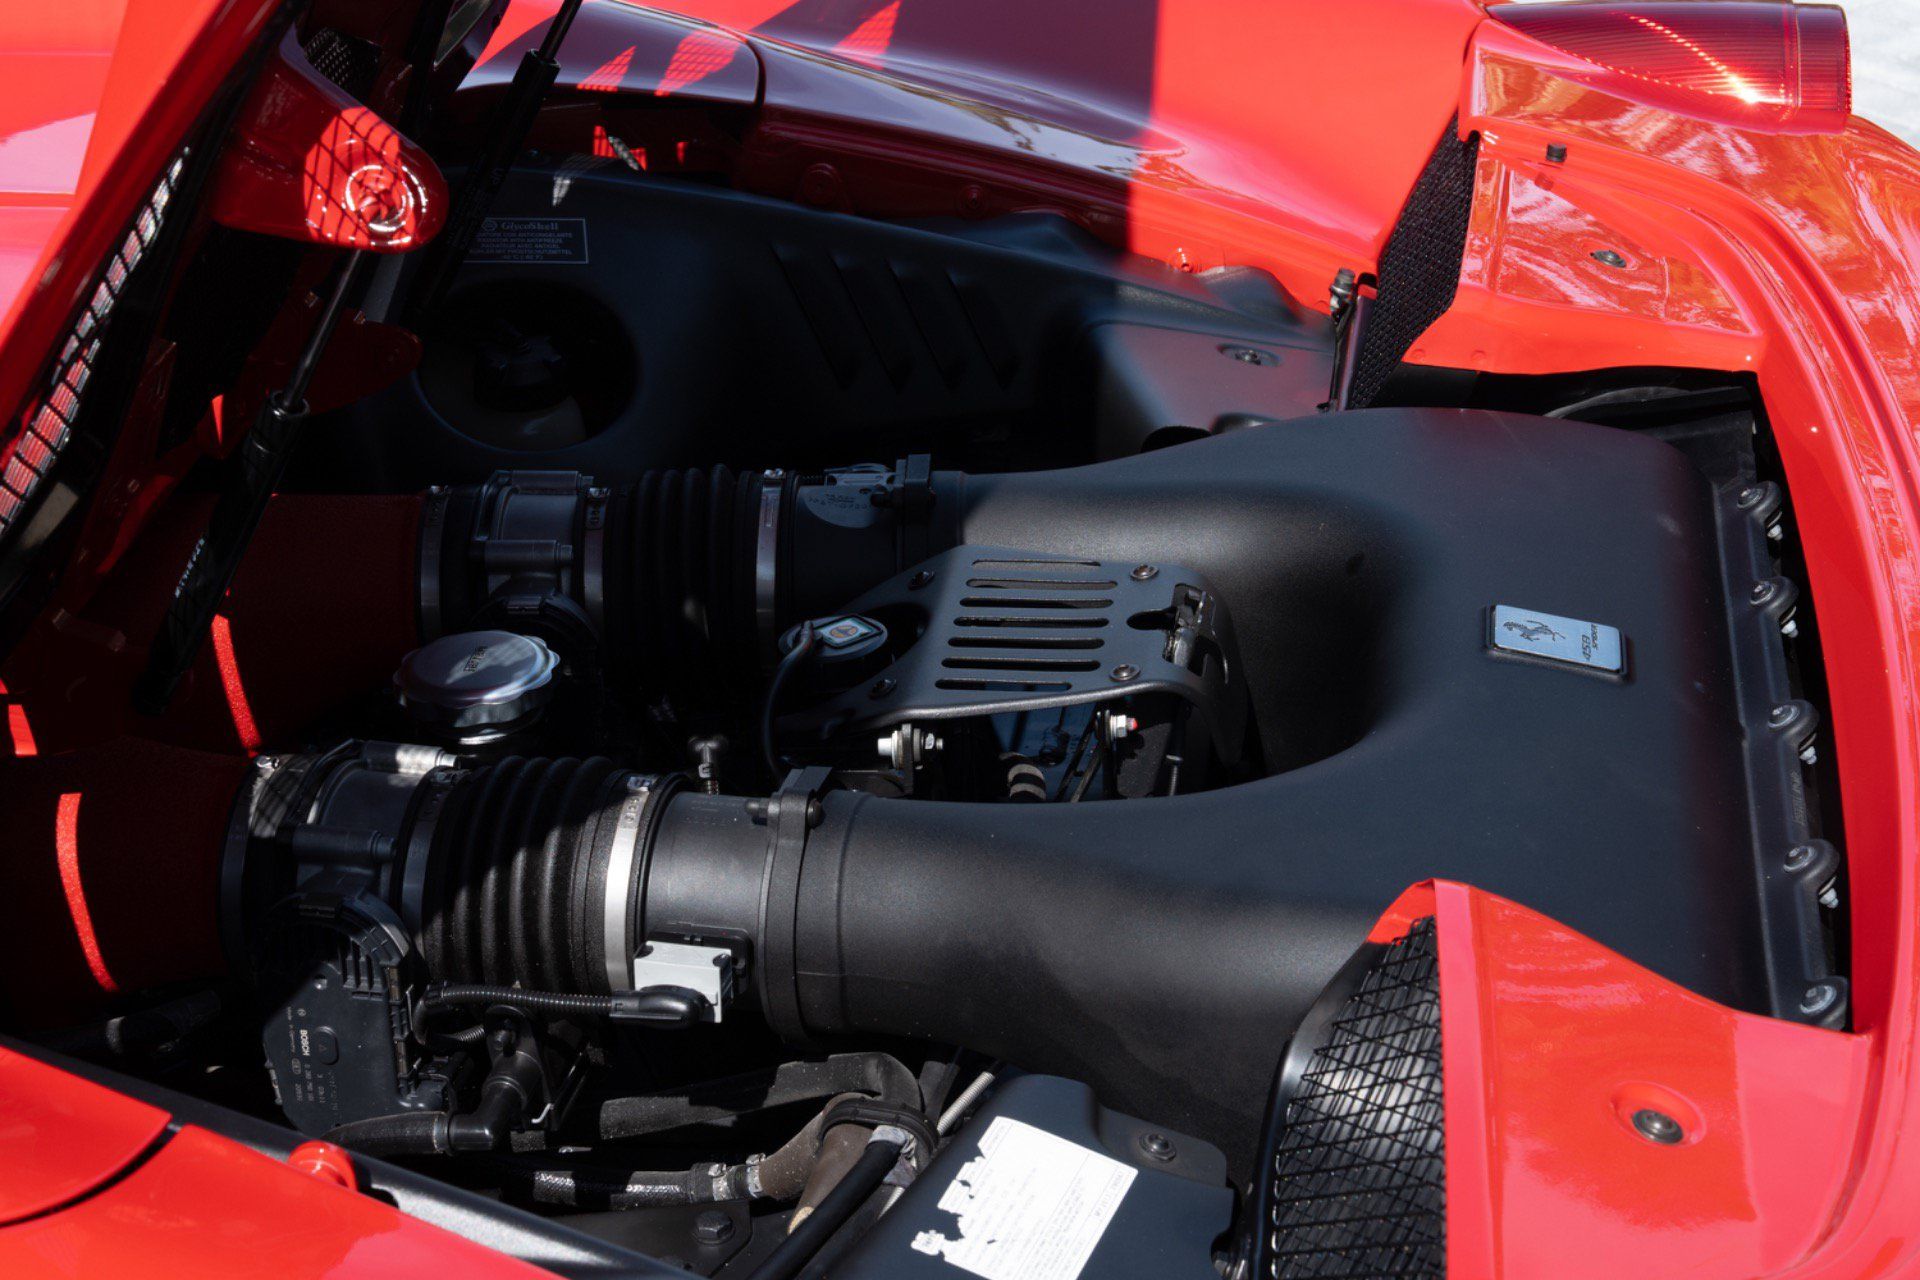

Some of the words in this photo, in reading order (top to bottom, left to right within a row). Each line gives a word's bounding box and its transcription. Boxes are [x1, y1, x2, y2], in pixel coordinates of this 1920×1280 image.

[501, 221, 558, 231] GlycoShell
[1581, 634, 1592, 661] 458
[300, 1029, 311, 1056] BOSCH
